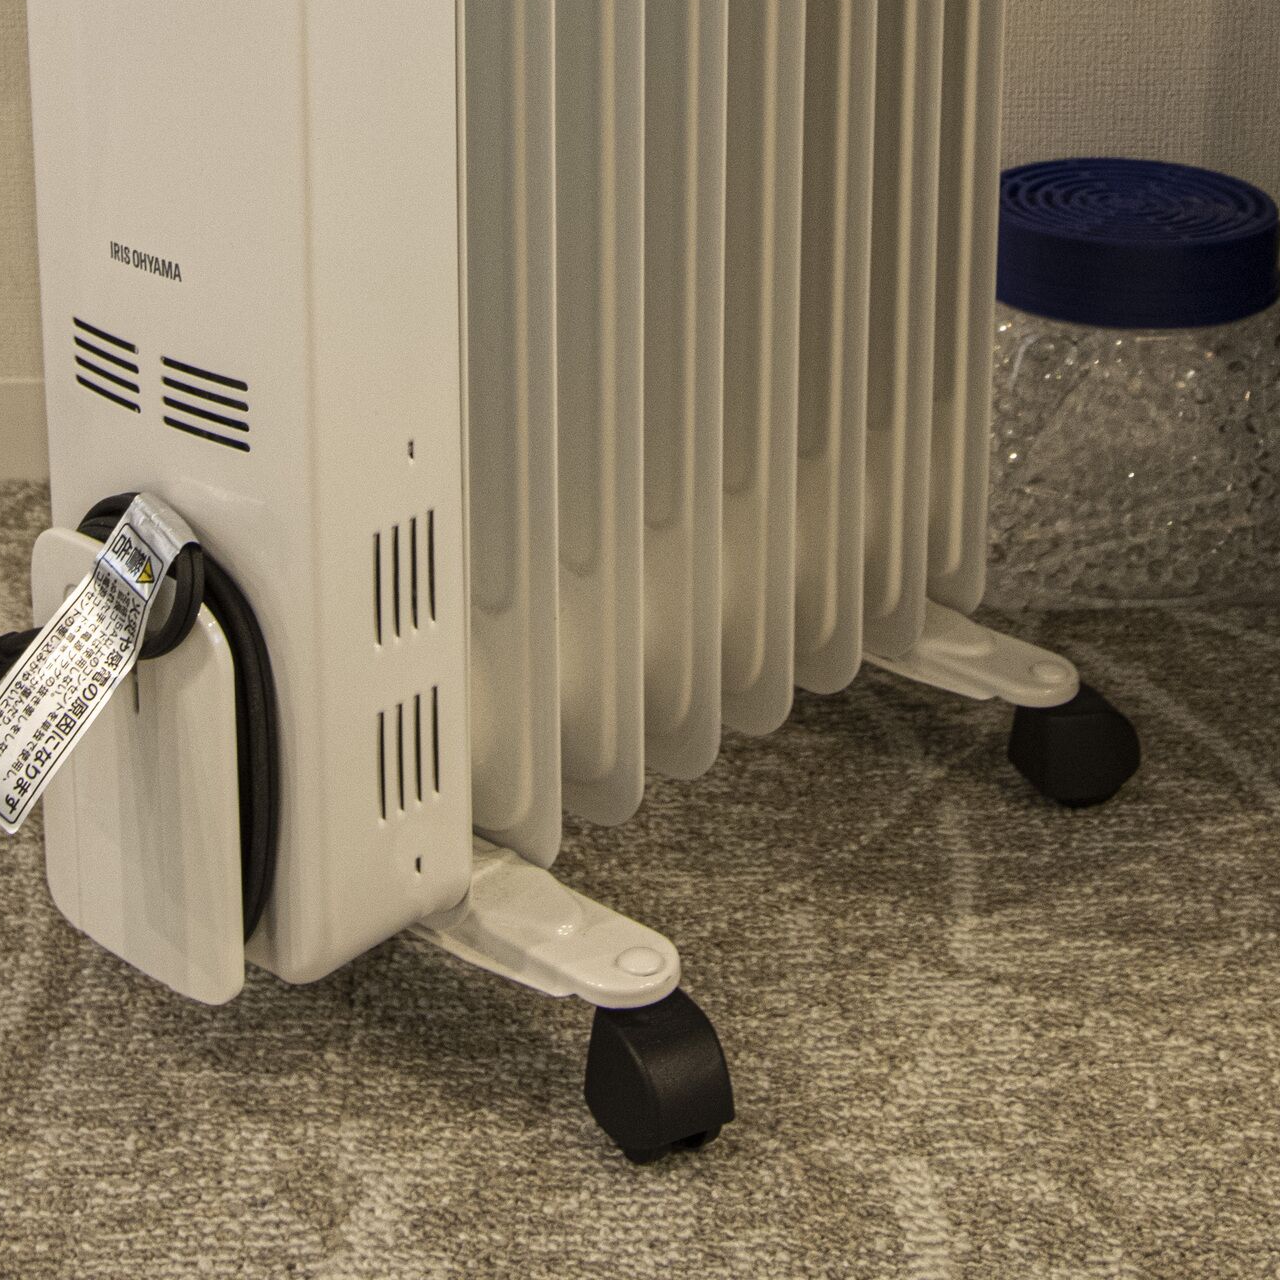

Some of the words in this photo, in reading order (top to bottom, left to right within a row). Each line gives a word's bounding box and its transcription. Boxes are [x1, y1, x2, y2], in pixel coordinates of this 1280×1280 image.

[110, 241, 131, 265] IRIS
[132, 249, 182, 282] OHYAMA
[110, 534, 148, 577] 警告
[2, 598, 141, 815] 火災や感電の原因になります
